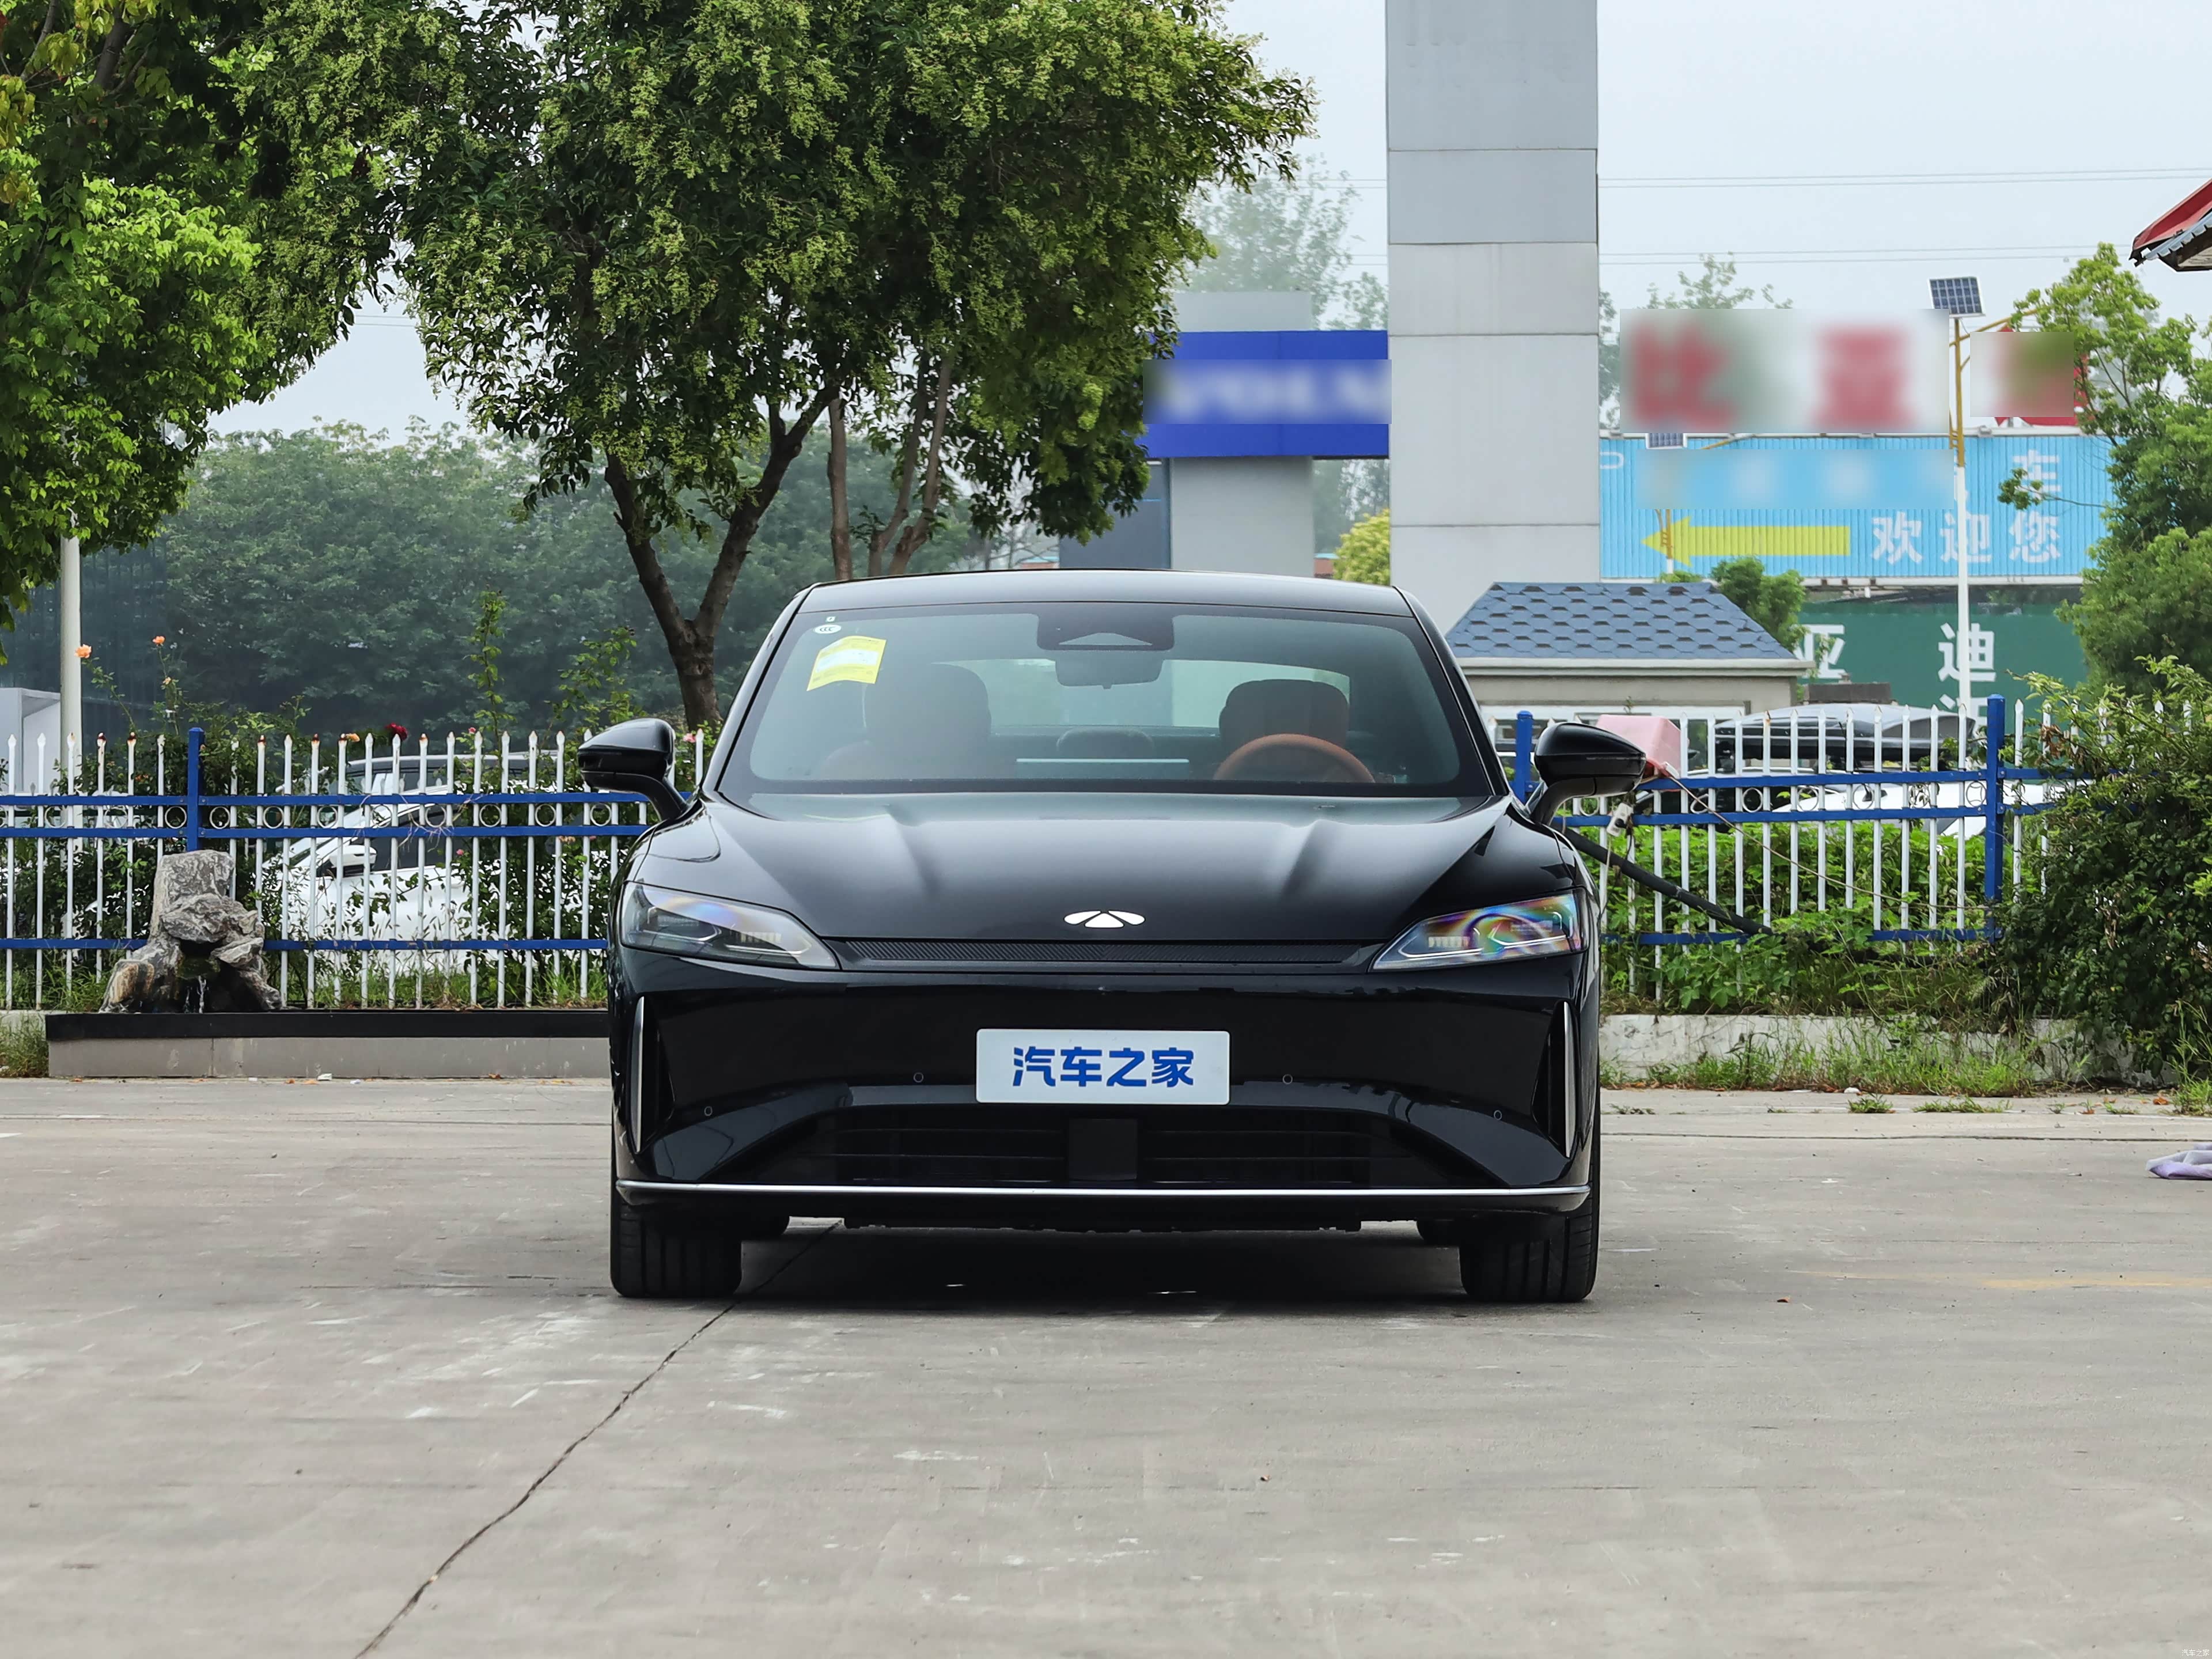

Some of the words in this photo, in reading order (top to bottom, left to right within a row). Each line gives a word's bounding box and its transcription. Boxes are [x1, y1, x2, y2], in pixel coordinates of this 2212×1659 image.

[1872, 510, 2061, 565] 欢迎您
[1013, 1046, 1194, 1088] 汽车之家
